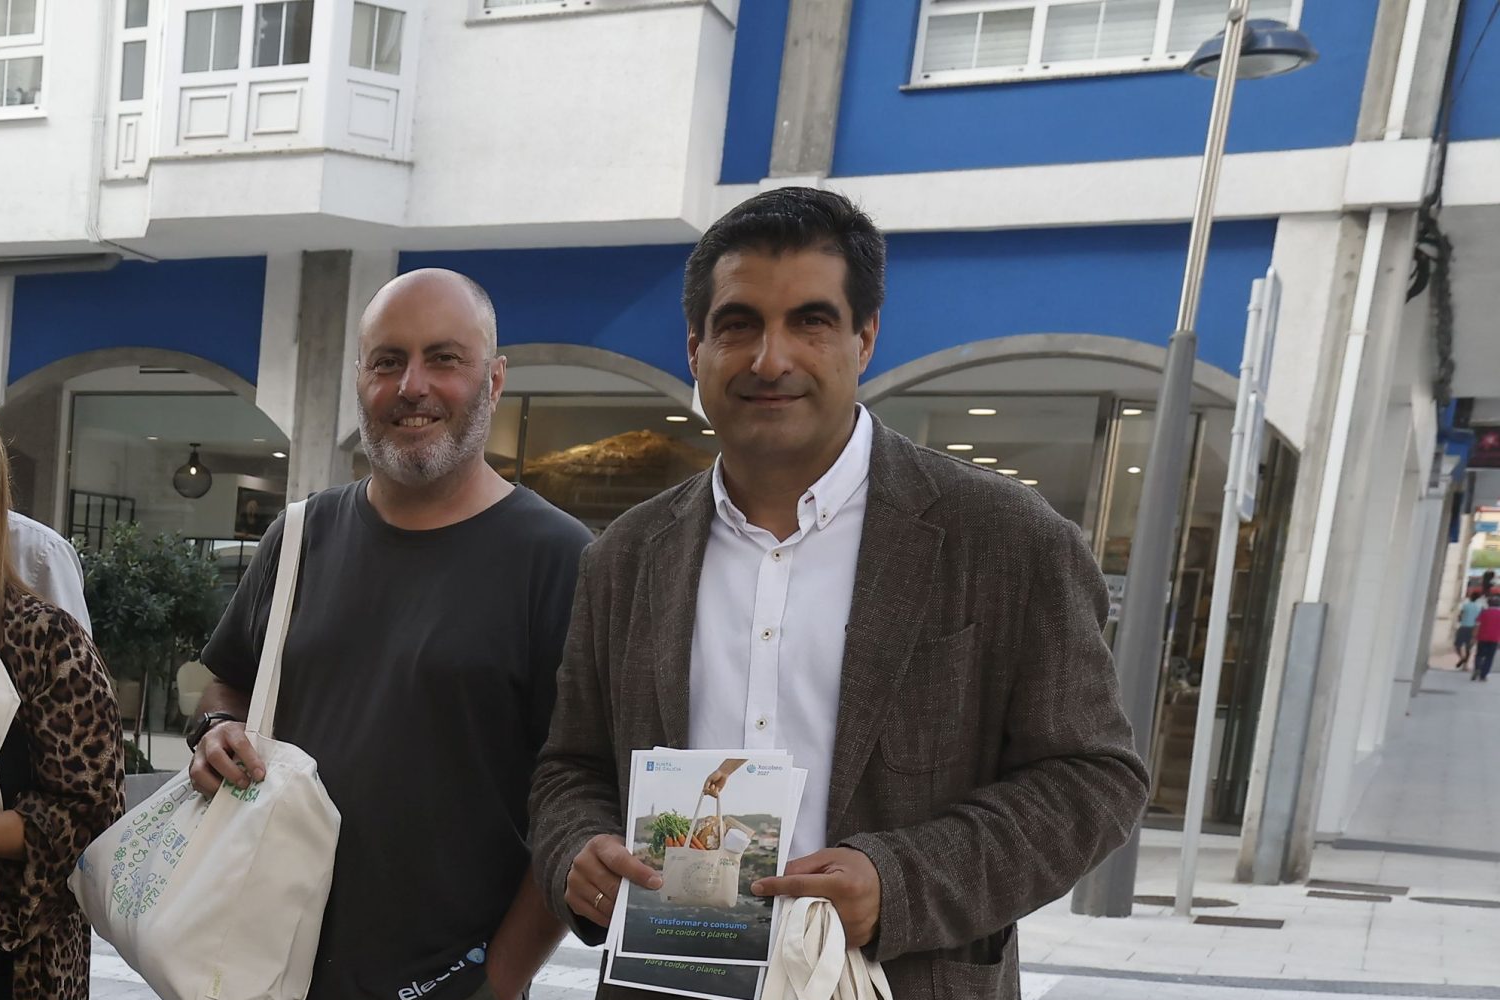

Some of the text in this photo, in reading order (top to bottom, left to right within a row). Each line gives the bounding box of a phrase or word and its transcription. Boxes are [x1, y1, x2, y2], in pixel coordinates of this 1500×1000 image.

[649, 916, 748, 930] Transformar o consumo
[675, 928, 699, 937] coidar
[706, 930, 738, 939] planeta
[664, 960, 688, 969] coidar
[695, 964, 727, 976] planeta
